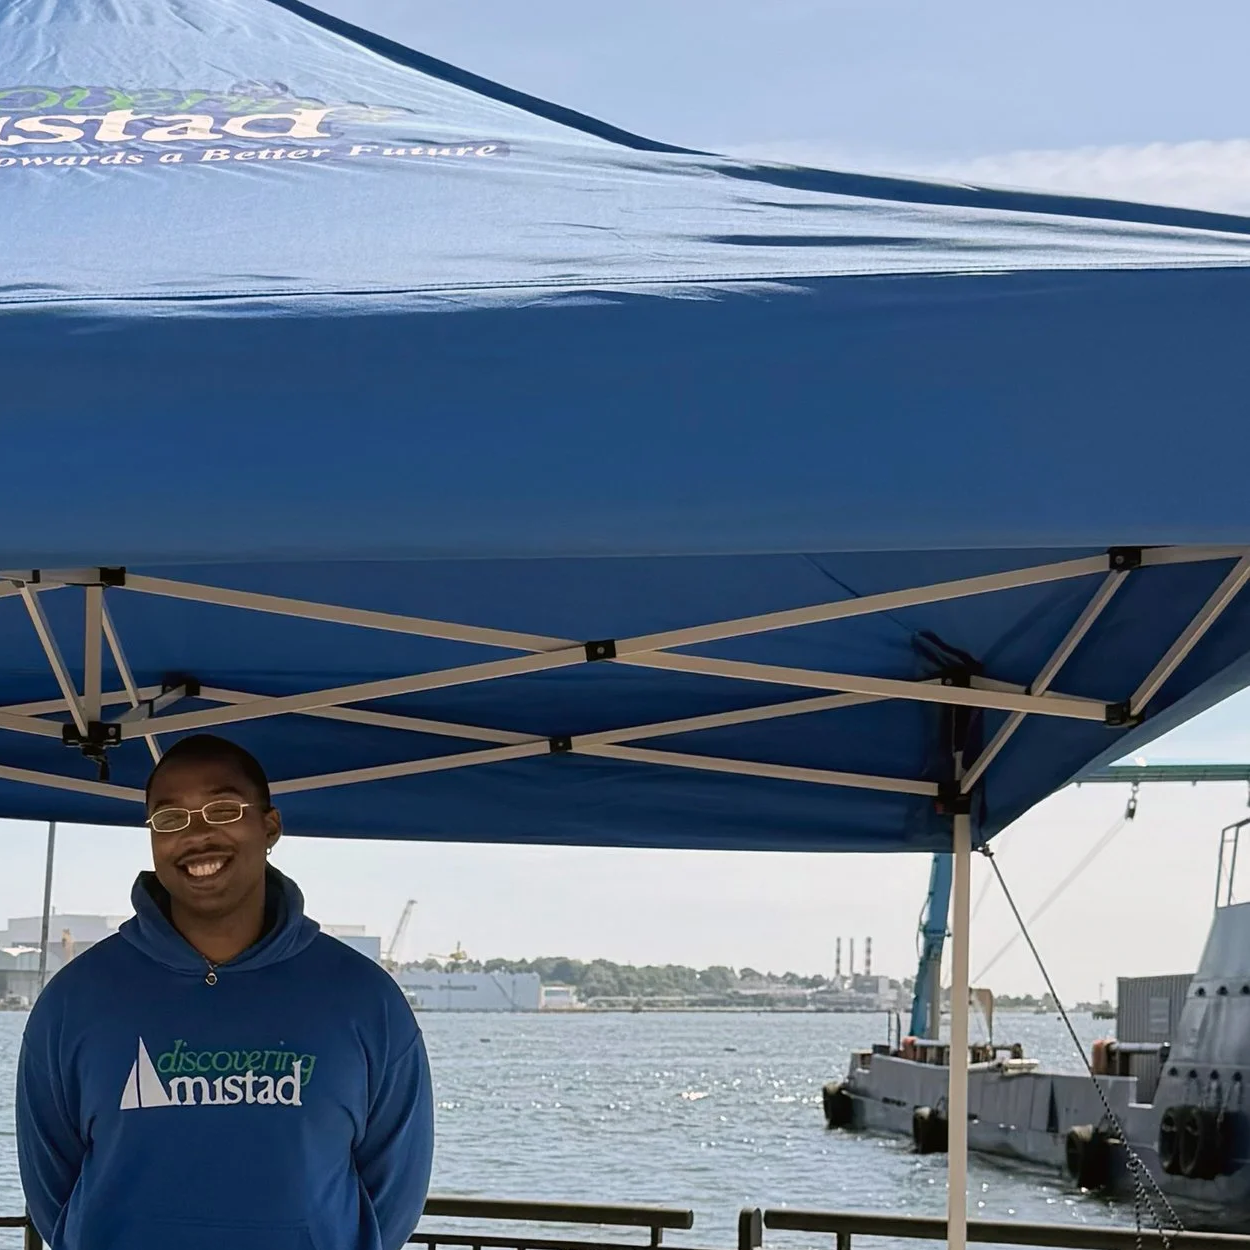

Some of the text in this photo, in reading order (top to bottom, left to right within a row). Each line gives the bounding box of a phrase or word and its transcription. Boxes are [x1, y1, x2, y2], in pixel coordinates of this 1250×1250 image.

[158, 152, 183, 164] a
[200, 144, 332, 162] Better
[349, 143, 499, 157] Future
[157, 1039, 317, 1087] discovering
